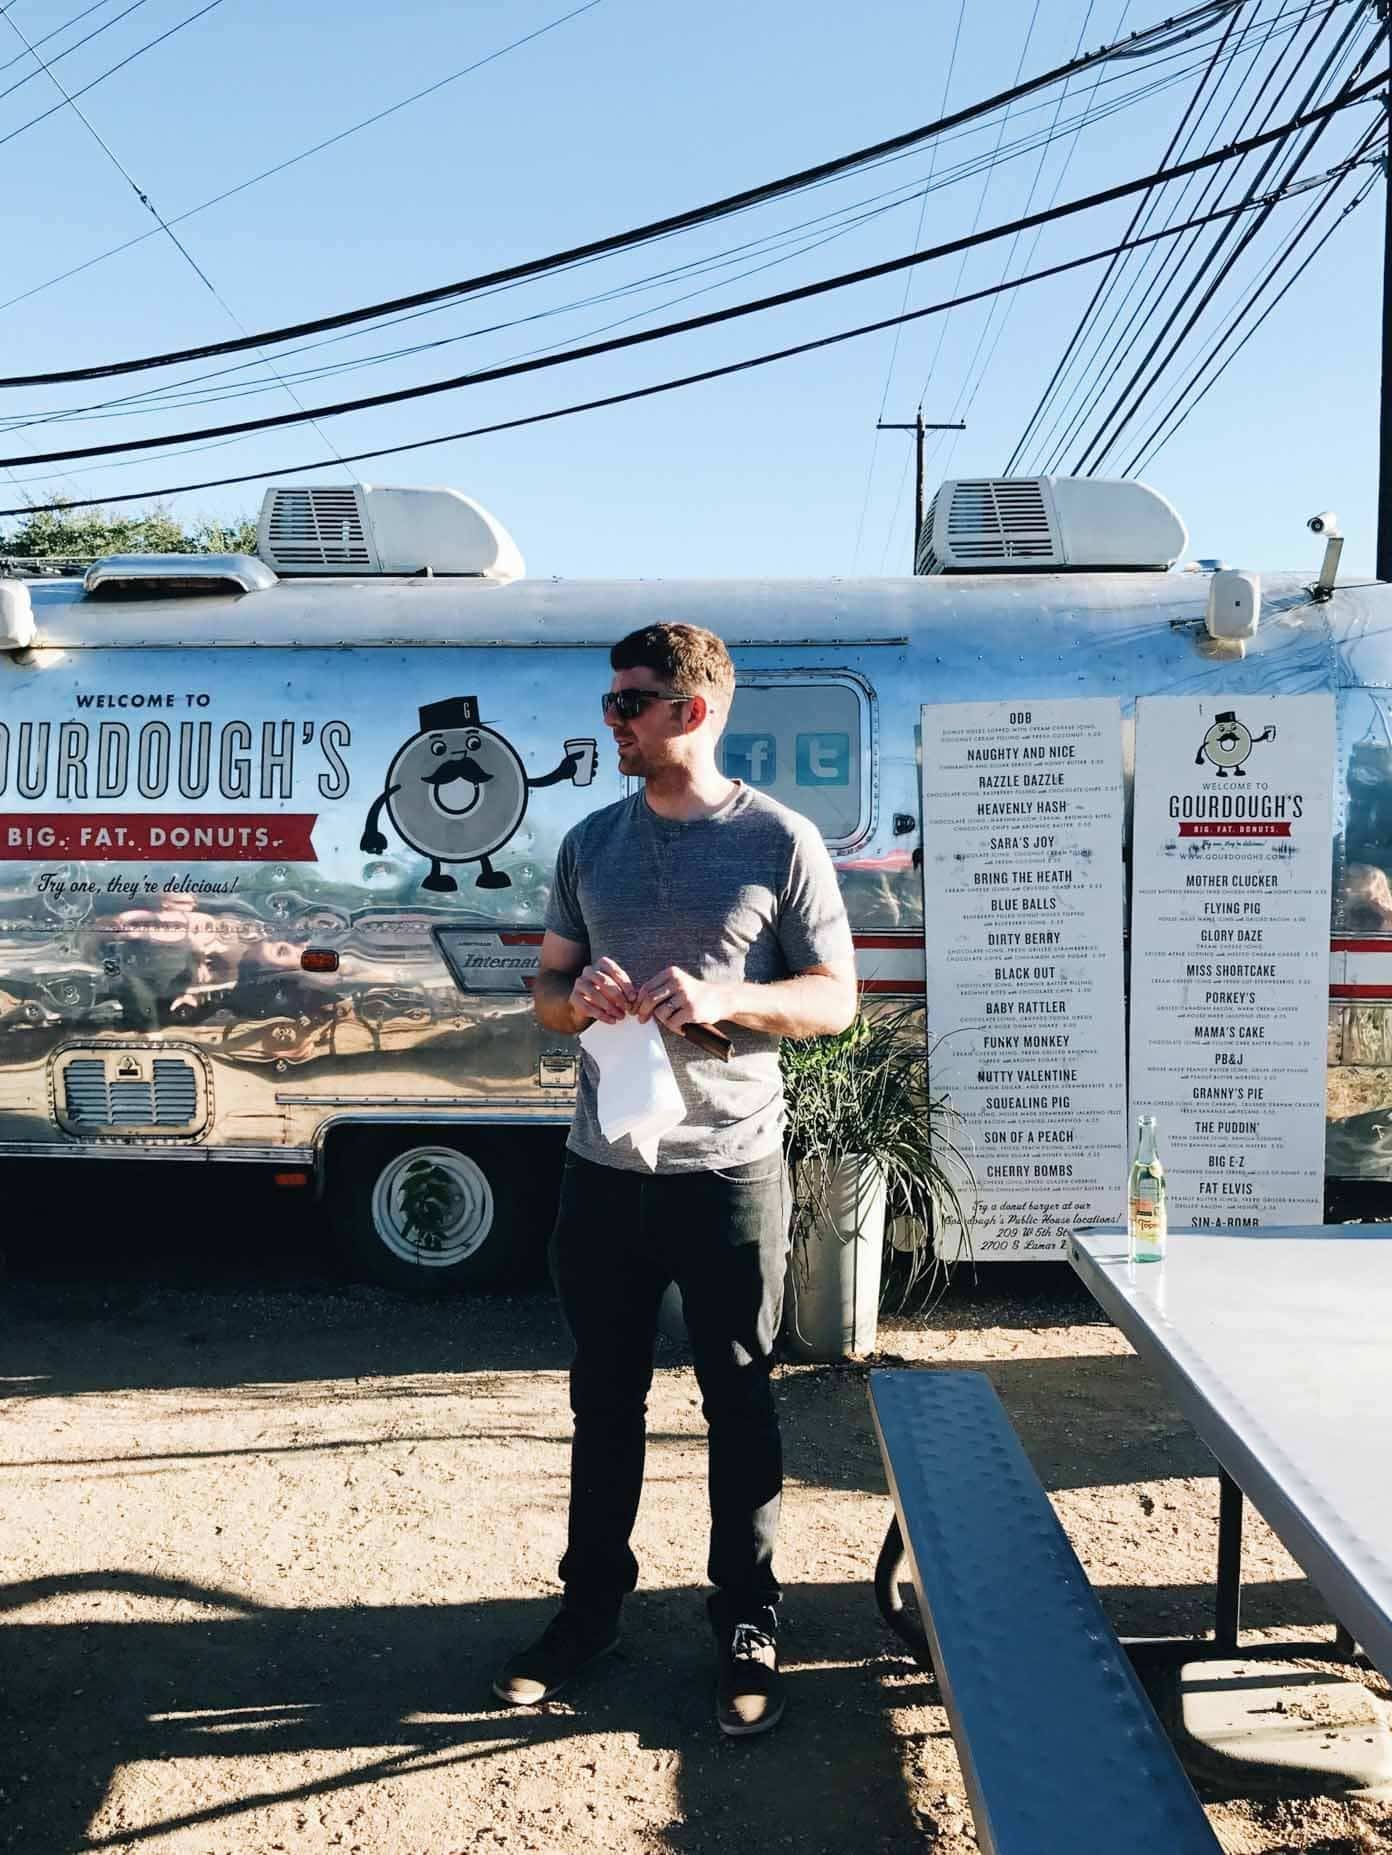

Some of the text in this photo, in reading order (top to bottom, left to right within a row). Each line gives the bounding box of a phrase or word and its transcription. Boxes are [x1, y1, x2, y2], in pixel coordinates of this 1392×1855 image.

[77, 694, 210, 707] WELCOME TO
[464, 702, 470, 719] G
[1010, 712, 1031, 724] ODB
[808, 739, 839, 778] t
[968, 746, 1074, 760] NAUGHTY AND NICE
[745, 740, 768, 781] f
[979, 774, 1064, 788] RAZZLE DAZZLE
[978, 801, 1066, 815] HEAVENLY HASH
[1170, 795, 1302, 817] GOURDOUGH'S
[8, 827, 279, 847] BIG. FAT. DONUTS.
[991, 836, 1054, 849] SARA'S JOY
[975, 870, 1072, 884] BRING THE HEATH
[1187, 875, 1277, 887] MOTHER CLUCKER
[38, 873, 239, 901] Try one, they're delicious!
[992, 898, 1056, 911] BLUE BALLS
[1205, 903, 1260, 914] FLYING PIG
[988, 933, 1060, 945] DIRTY BERRY
[1201, 930, 1262, 941] GLORY DAZE
[464, 954, 541, 968] Internat
[995, 967, 1055, 979] BLACK OUT
[1187, 965, 1275, 976] MISS SHORTCAKE
[1206, 992, 1255, 1003] PORKEY'S
[987, 1001, 1065, 1014] BABY RATTLER
[1195, 1027, 1264, 1038] MAMA'S CAKE
[984, 1036, 1069, 1048] FUNKY MONKEY
[1216, 1054, 1243, 1064] PB&J
[978, 1070, 1076, 1082] NUTTY VALENTINE
[1193, 1088, 1263, 1099] GRANNY'S PIE
[986, 1097, 1069, 1109] SQUEALING PIG
[1196, 1122, 1259, 1133] THE PUDDIN'
[985, 1131, 1073, 1143] SON OF A PEACH
[1209, 1156, 1244, 1167] BIG E-Z
[987, 1165, 1072, 1177] CHERRY BOMBS
[1200, 1183, 1252, 1194] FAT ELVIS
[972, 1201, 987, 1211] Try
[1000, 1202, 1027, 1211] donut
[1029, 1201, 1059, 1212] burger
[1062, 1202, 1073, 1210] at
[944, 1213, 1121, 1228] Goudough's Public House locations!
[996, 1229, 1018, 1238] 209
[1023, 1228, 1033, 1237] W
[1036, 1228, 1051, 1237] 5th
[980, 1241, 1008, 1250] 2700
[1012, 1241, 1019, 1250] S
[1024, 1240, 1056, 1250] Lamar
